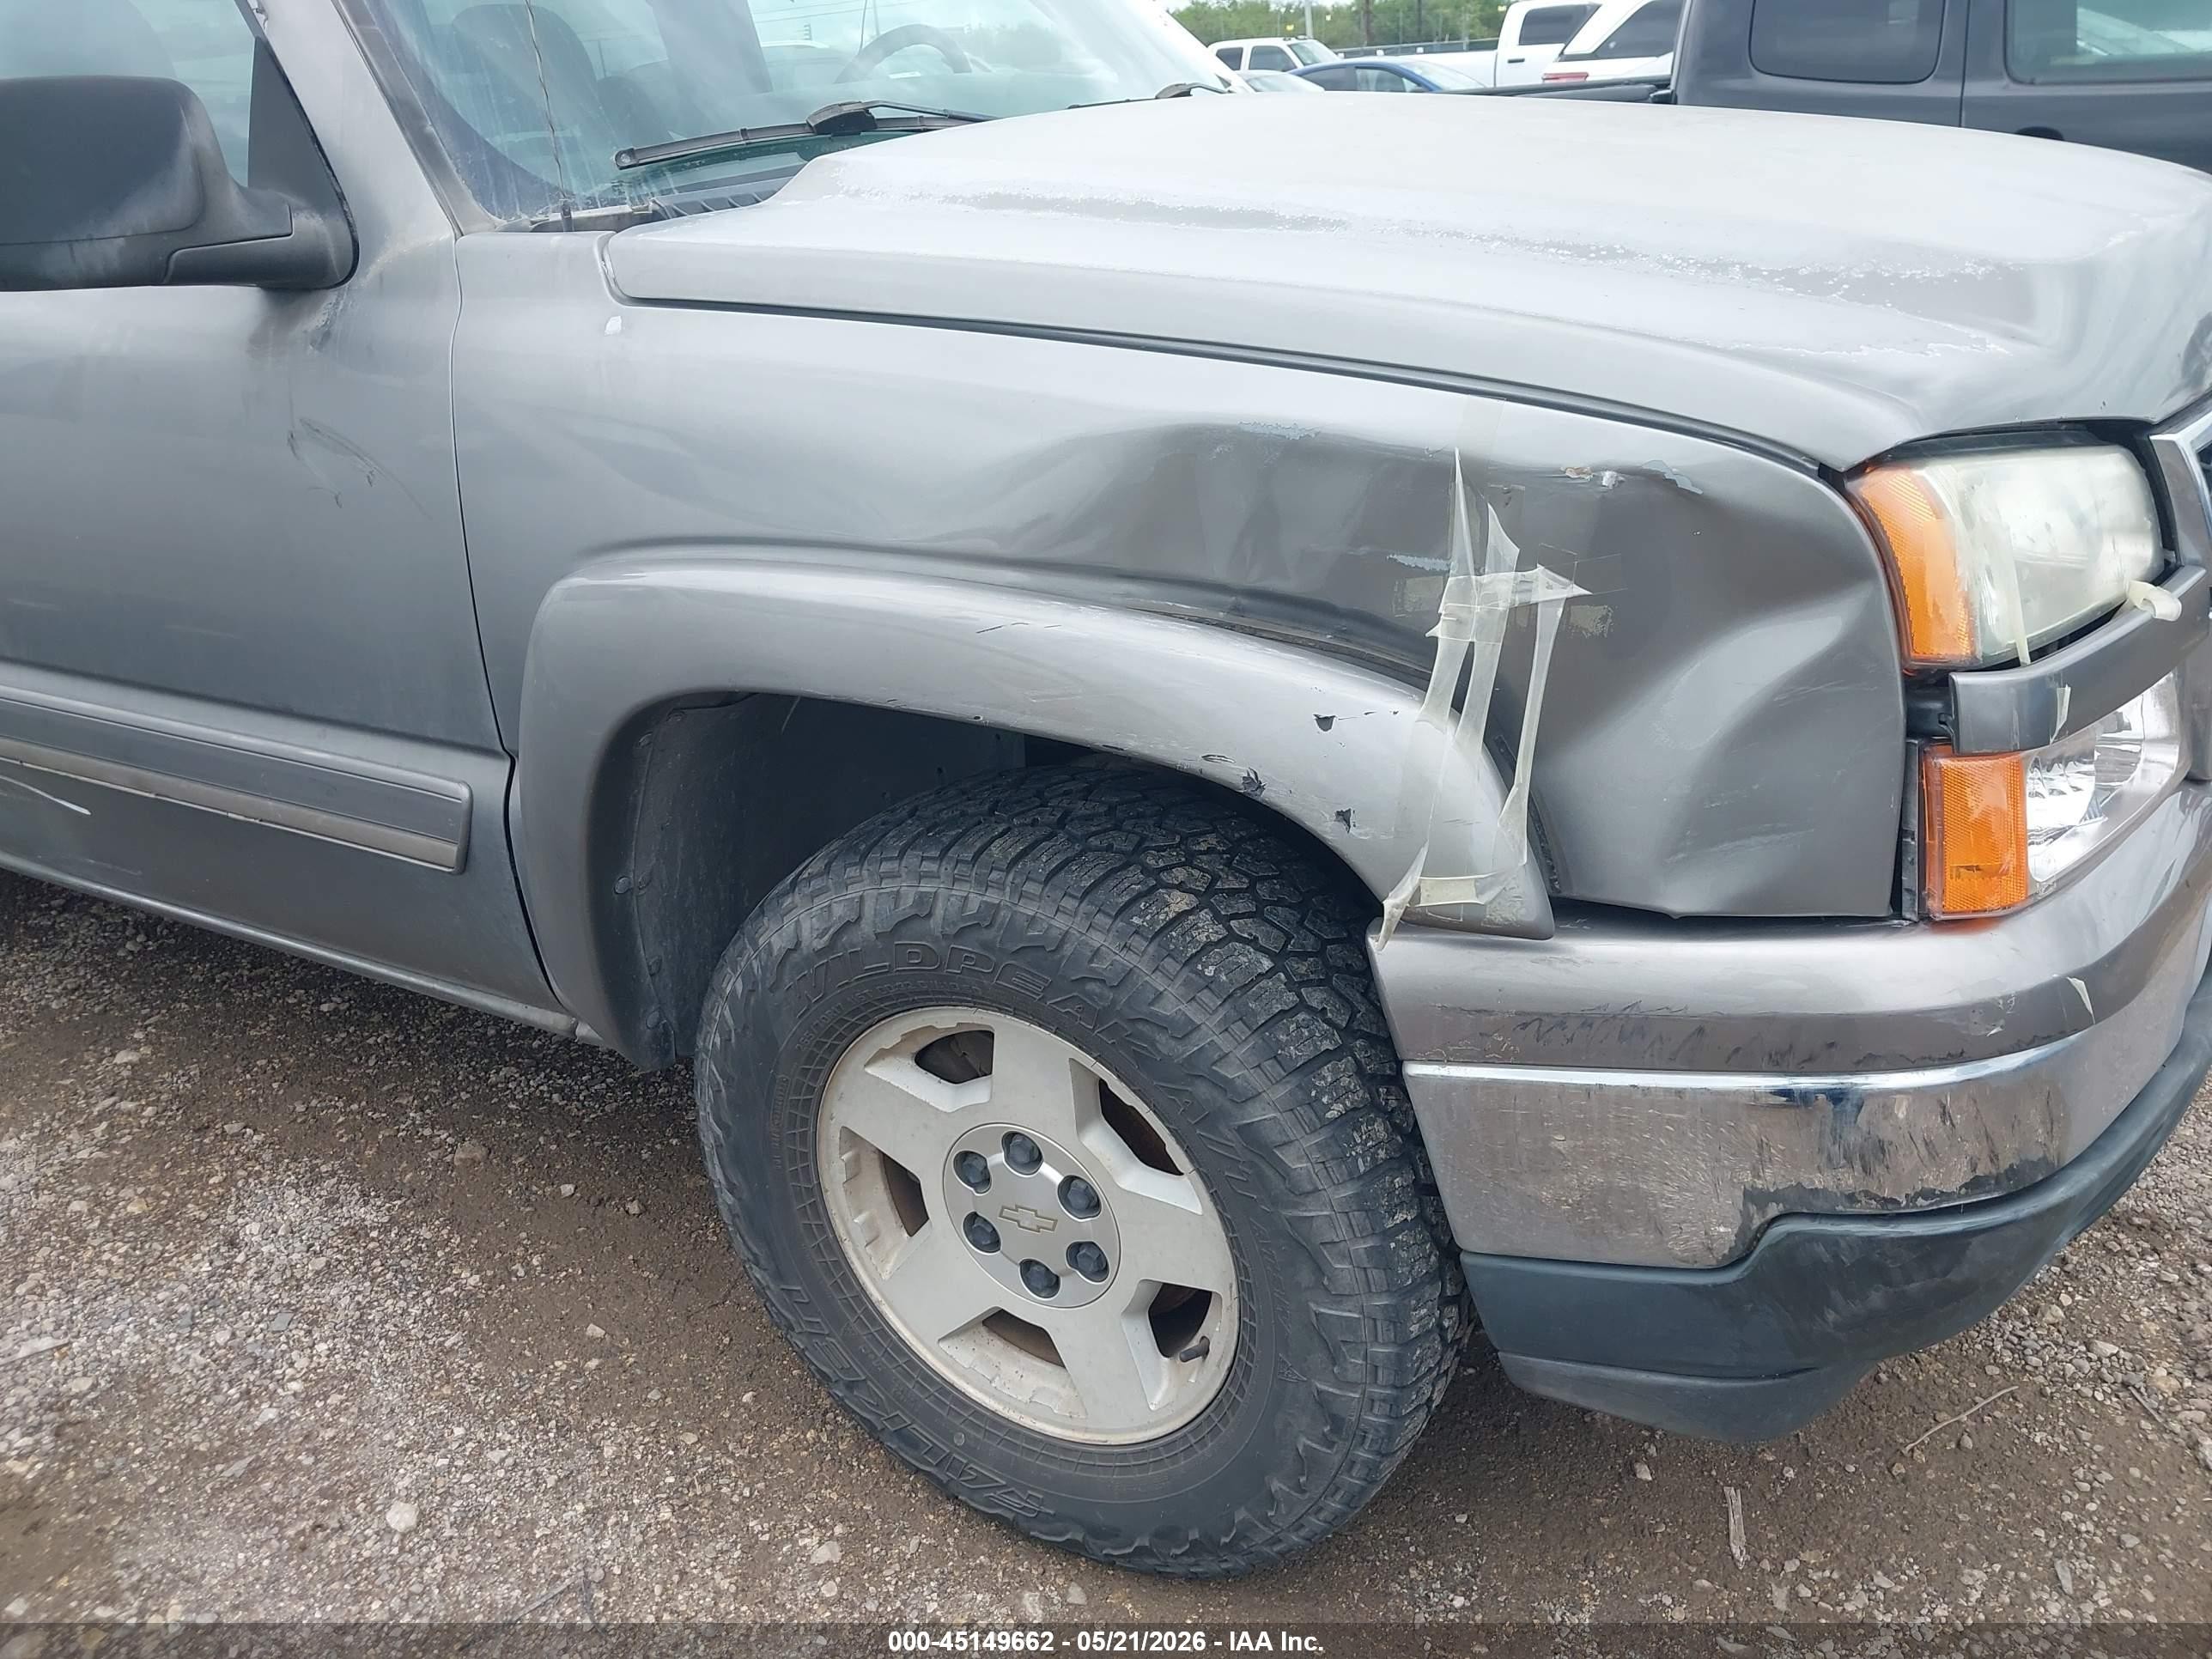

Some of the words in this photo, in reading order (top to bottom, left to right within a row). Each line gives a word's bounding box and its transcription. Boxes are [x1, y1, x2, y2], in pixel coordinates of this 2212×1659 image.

[783, 940, 1162, 1071] WILDPEAK
[795, 1001, 845, 1052] 265/70R17
[776, 1284, 1056, 1518] FALKEN
